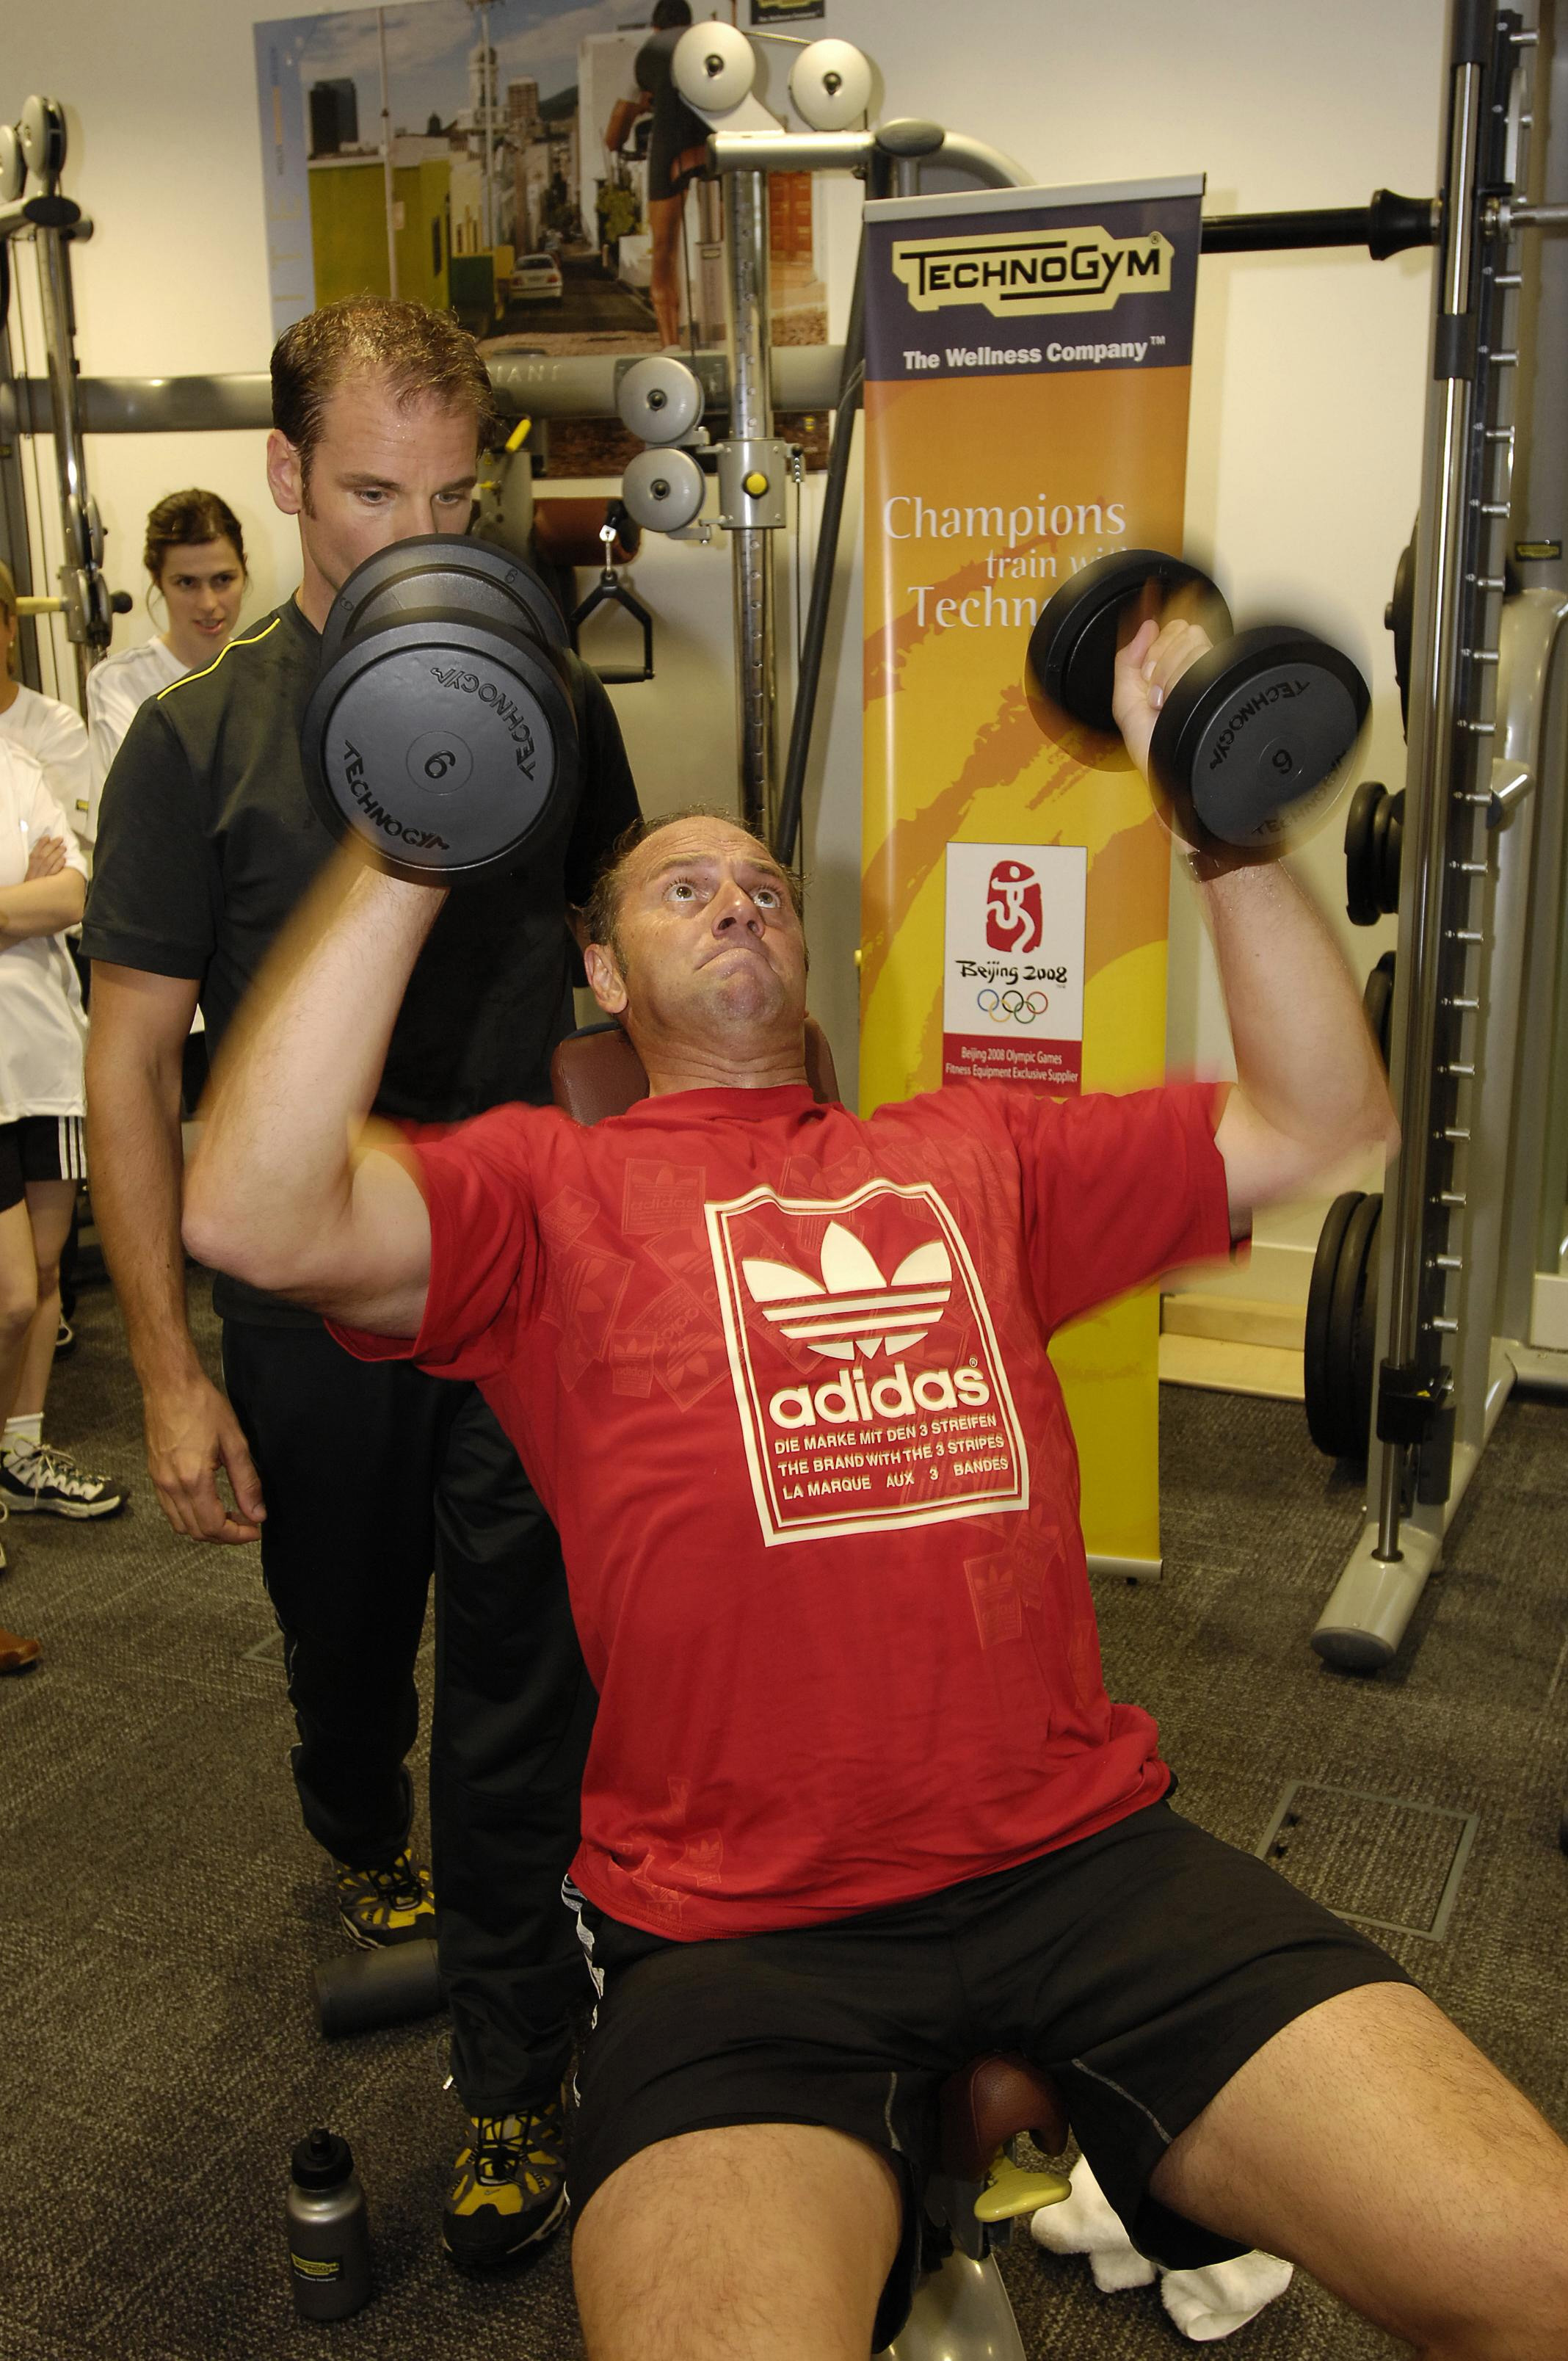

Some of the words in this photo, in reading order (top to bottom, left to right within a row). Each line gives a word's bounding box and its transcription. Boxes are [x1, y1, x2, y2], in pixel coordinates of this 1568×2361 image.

[904, 350, 940, 369] The
[945, 343, 1042, 367] Wellness
[882, 493, 1126, 548] Champions
[986, 548, 1057, 579] train
[907, 585, 1052, 628] Techn
[956, 960, 1018, 985] Beijing
[1023, 965, 1067, 984] 2008
[961, 1046, 987, 1062] Beijing
[988, 1048, 1005, 1062] 2008
[1006, 1048, 1035, 1065] Olympic
[1037, 1051, 1062, 1065] Games
[973, 1064, 1012, 1079] Equipment
[1012, 1065, 1048, 1080] Exclusive
[1048, 1067, 1078, 1083] Supplier
[774, 1437, 800, 1454] DIE
[804, 1431, 857, 1451] MARKE
[860, 1429, 883, 1446] MIT
[888, 1426, 917, 1443] DEN
[919, 1424, 929, 1437] 3
[932, 1414, 998, 1435] STREIFEN
[777, 1459, 809, 1477] THE
[813, 1454, 865, 1473] BRAND
[865, 1451, 901, 1468] WITH
[902, 1446, 933, 1462] THE
[935, 1443, 945, 1457] 3
[948, 1435, 1005, 1454] STRIPES
[783, 1483, 804, 1500] LA
[807, 1476, 872, 1496] MARQUE
[886, 1471, 915, 1489] AUX
[929, 1468, 940, 1481] 3
[954, 1457, 1009, 1477] BANDES
